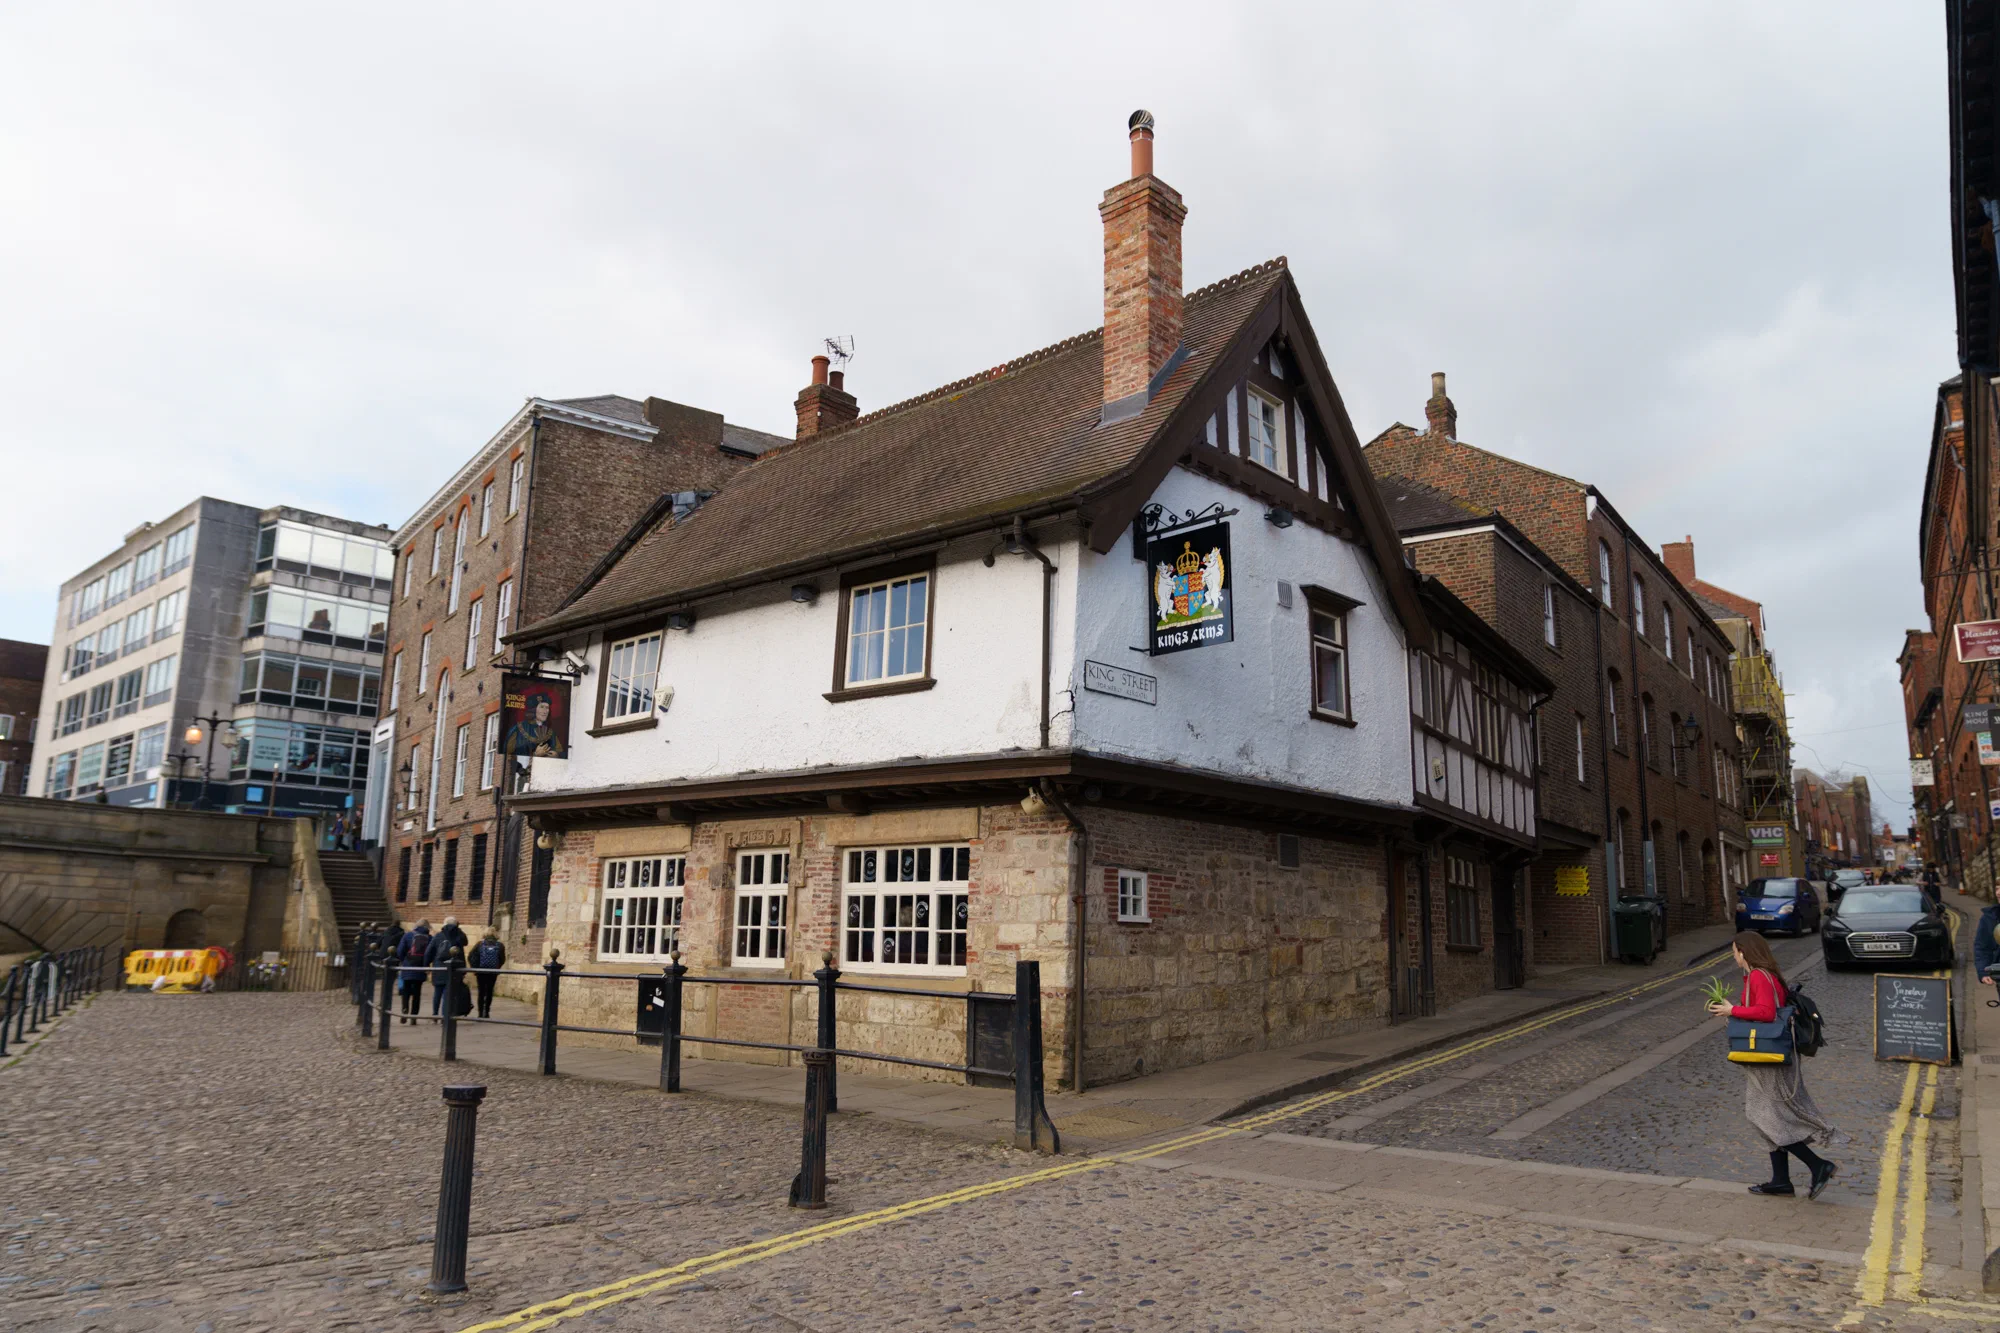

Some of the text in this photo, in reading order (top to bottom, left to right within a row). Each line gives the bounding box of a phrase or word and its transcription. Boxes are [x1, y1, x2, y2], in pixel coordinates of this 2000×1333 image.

[1157, 624, 1224, 648] KINGS ARMS
[1088, 664, 1155, 692] KING STREET
[505, 700, 526, 708] ARMS
[1750, 827, 1783, 838] VHC
[1886, 981, 1928, 1003] Sunday
